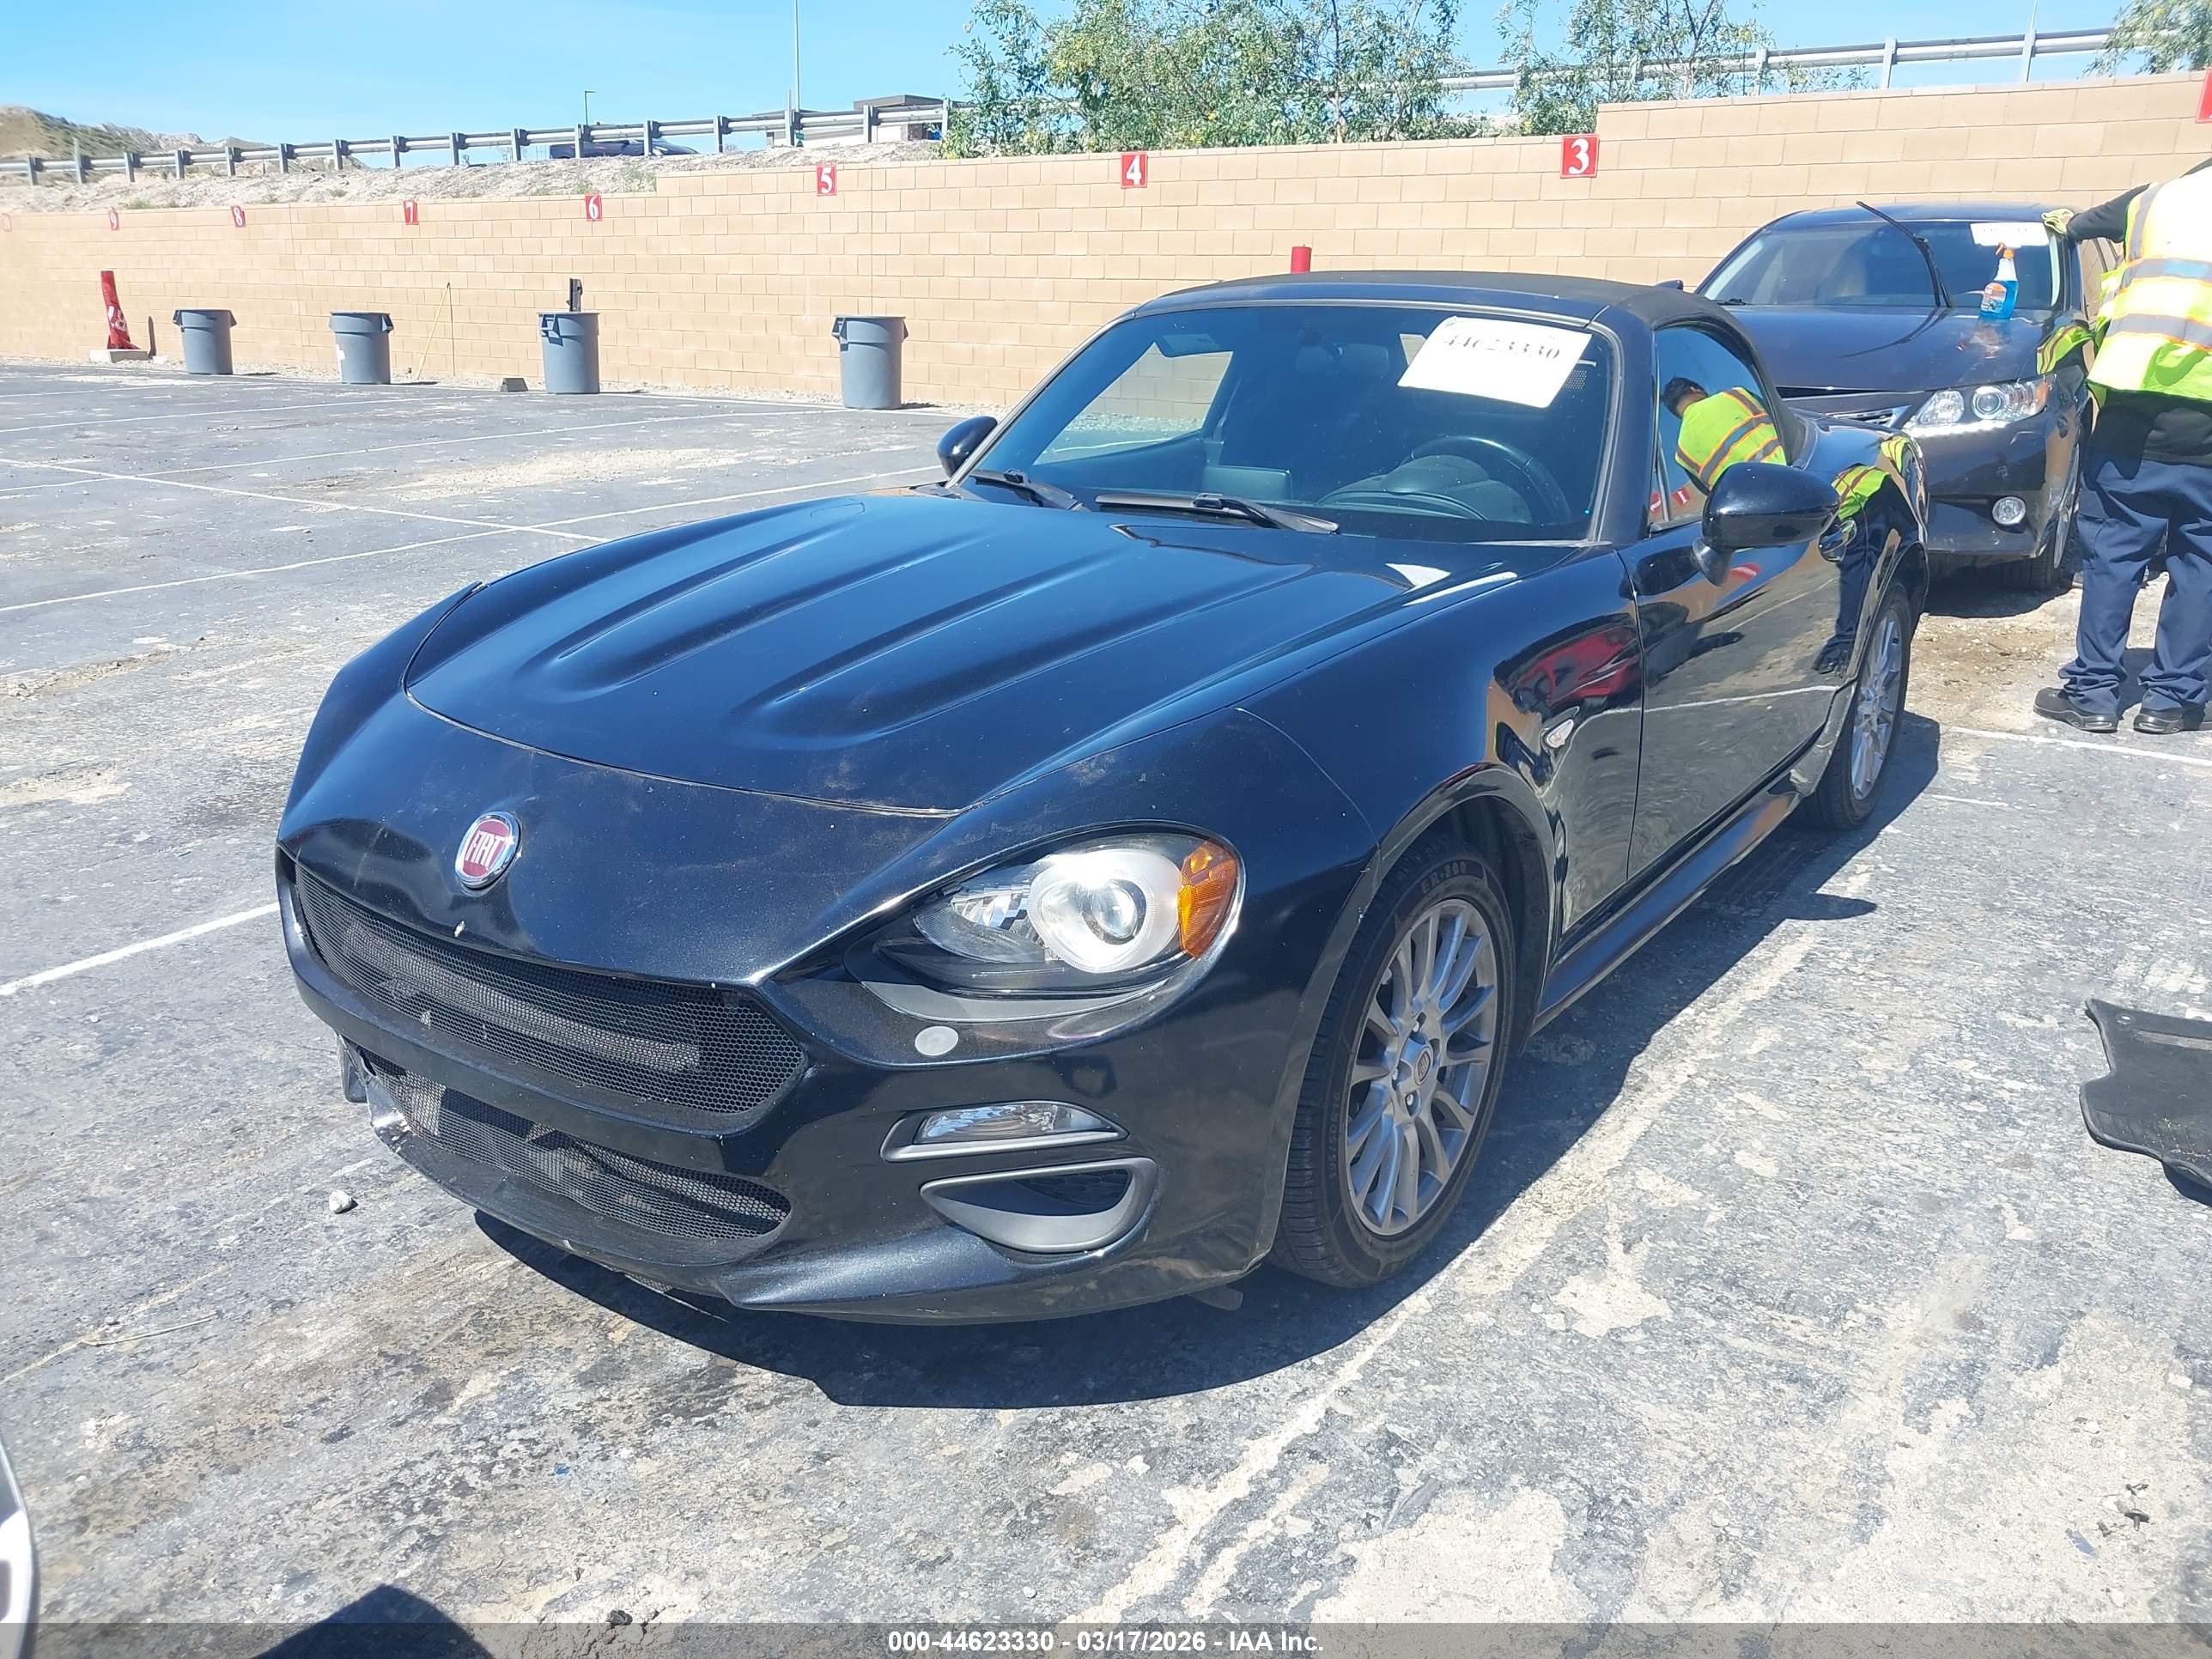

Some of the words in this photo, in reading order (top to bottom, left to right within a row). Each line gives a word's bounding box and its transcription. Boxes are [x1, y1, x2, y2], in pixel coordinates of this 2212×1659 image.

[1569, 138, 1589, 174] 3
[820, 167, 833, 194] 5
[1126, 155, 1142, 185] 4
[234, 207, 243, 226] 8
[405, 202, 414, 223] 7
[589, 196, 599, 220] 6
[465, 830, 506, 868] FIAT
